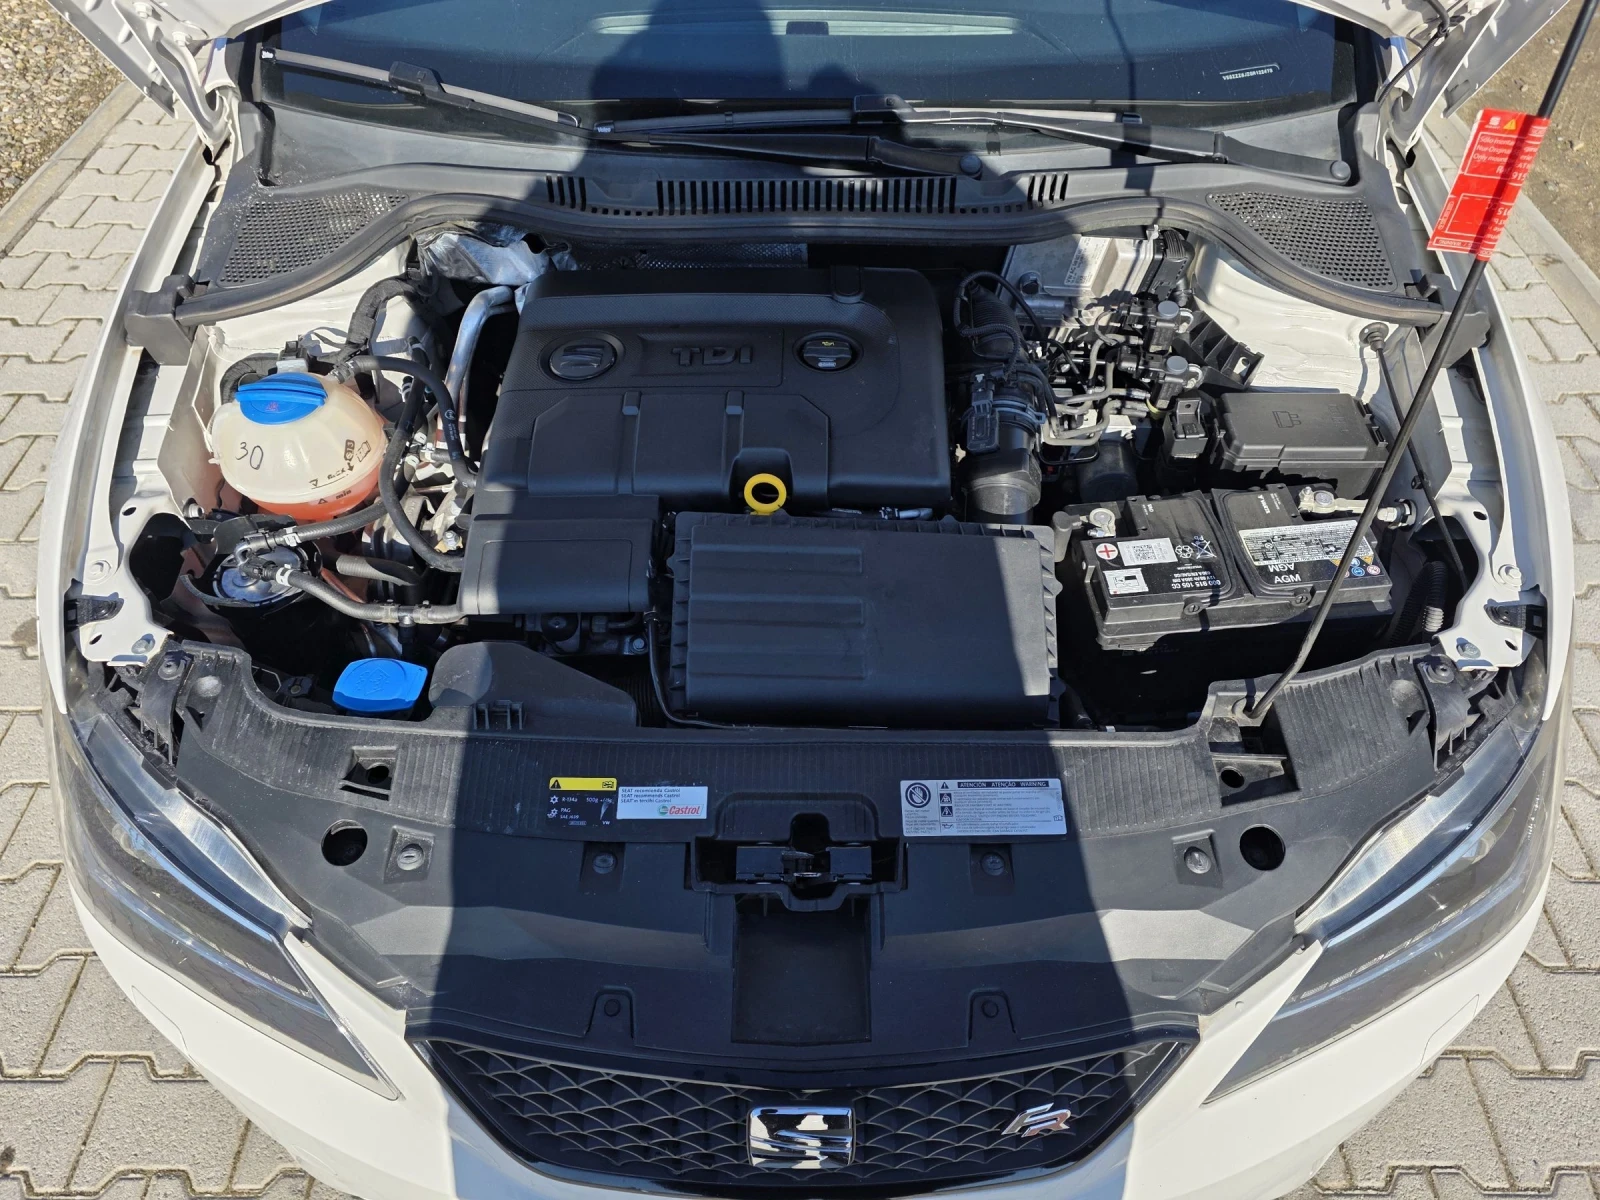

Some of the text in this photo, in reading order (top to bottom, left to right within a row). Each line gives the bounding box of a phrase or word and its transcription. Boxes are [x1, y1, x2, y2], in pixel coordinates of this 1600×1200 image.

[671, 346, 754, 367] TDI
[235, 441, 264, 470] 30
[335, 490, 352, 499] min
[1267, 562, 1295, 573] AGM
[1274, 573, 1302, 584] AGM
[668, 805, 701, 815] Castrol
[1001, 1102, 1072, 1138] FR
